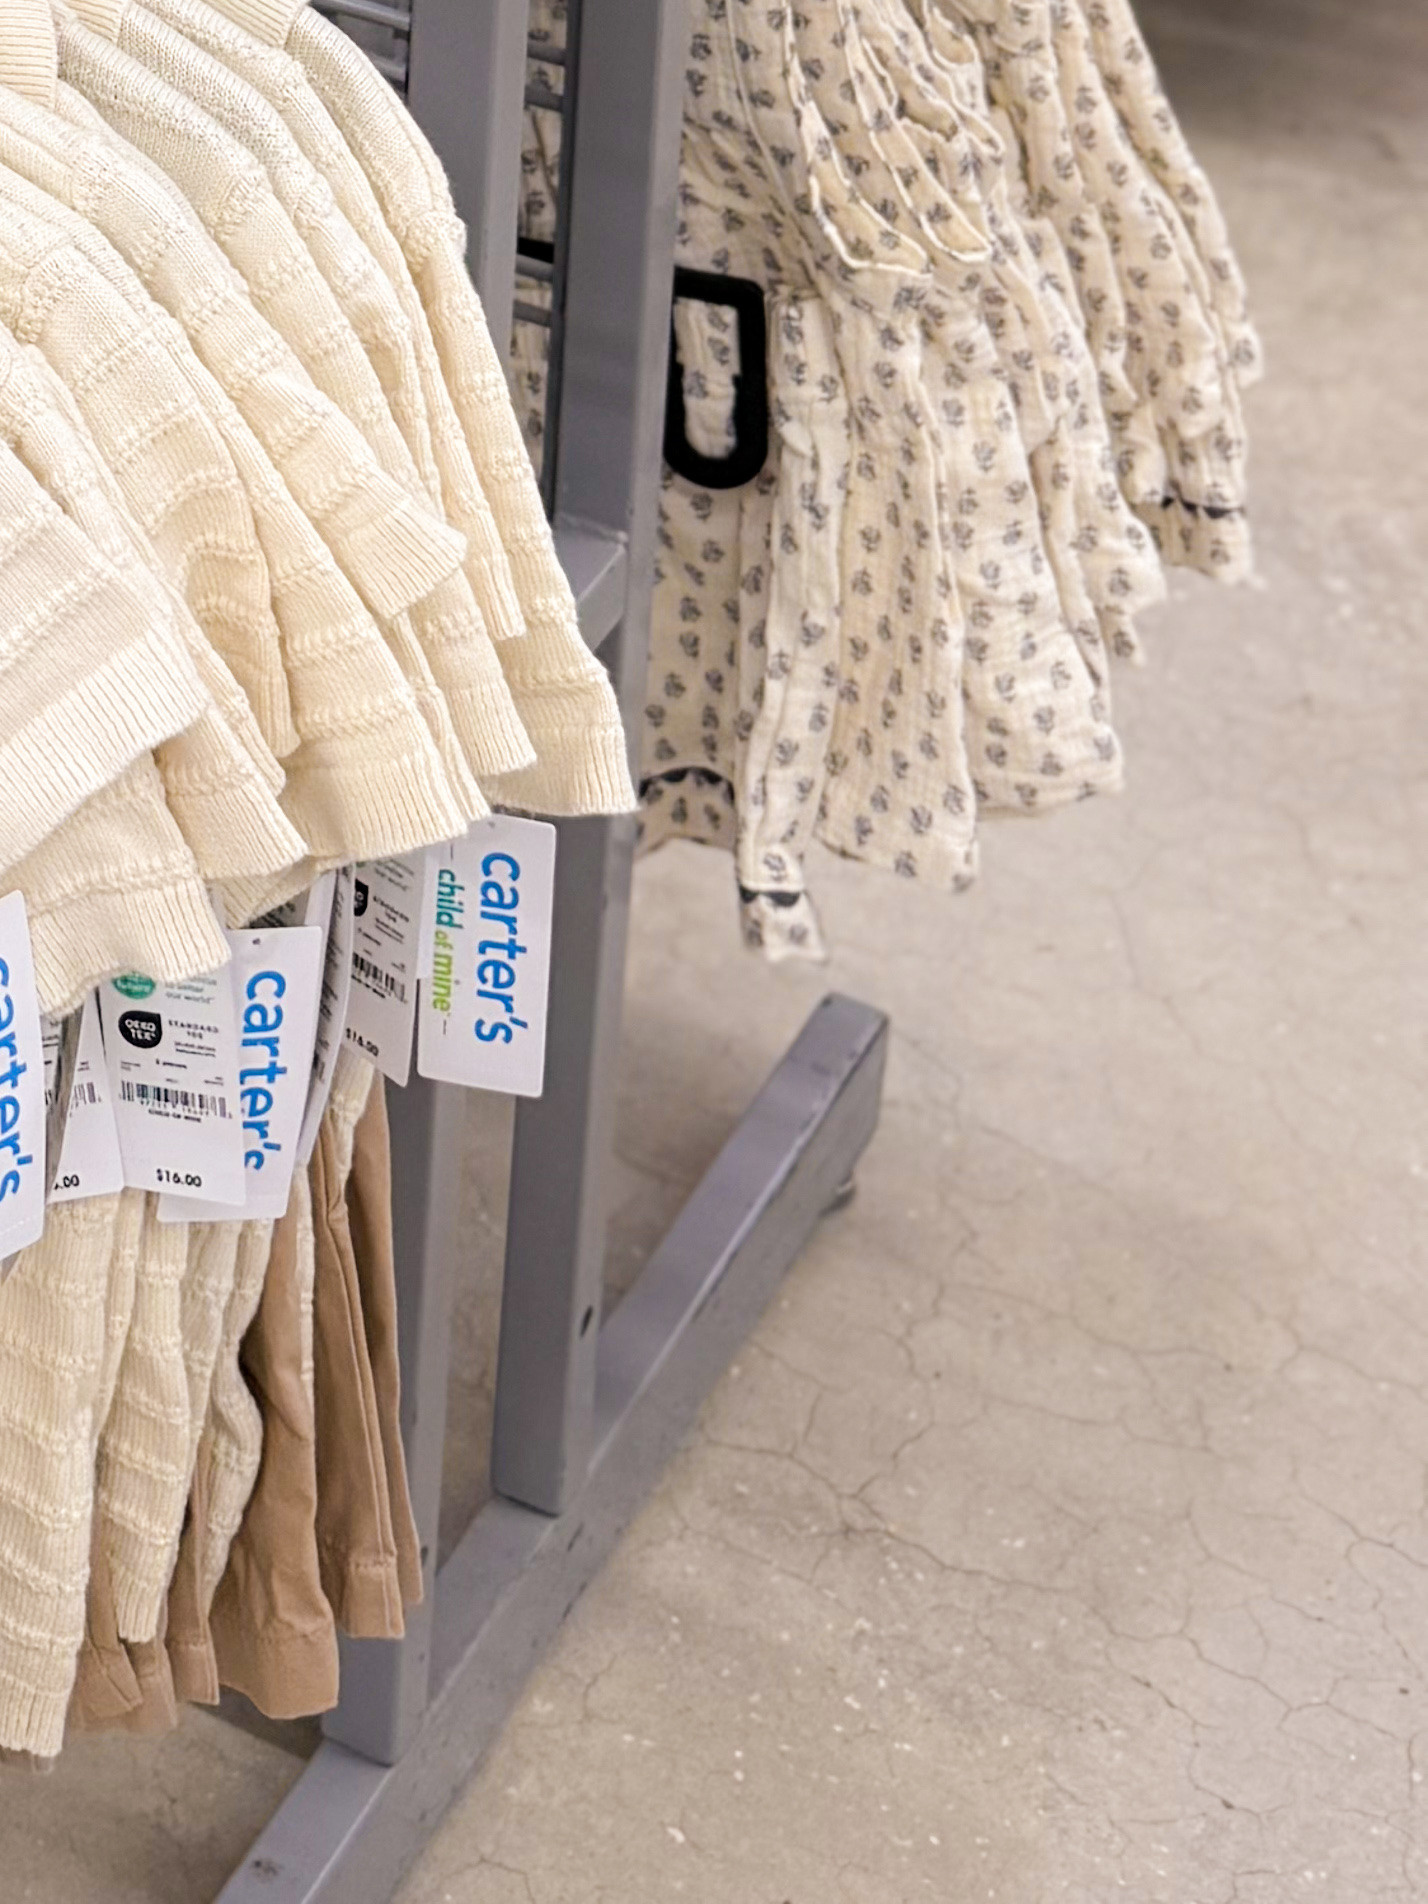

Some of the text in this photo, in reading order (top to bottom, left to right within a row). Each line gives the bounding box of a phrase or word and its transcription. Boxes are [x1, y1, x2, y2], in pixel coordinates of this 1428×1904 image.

[433, 869, 466, 1012] child of mine
[475, 852, 529, 1044] carter's
[156, 1167, 203, 1188] $16.00
